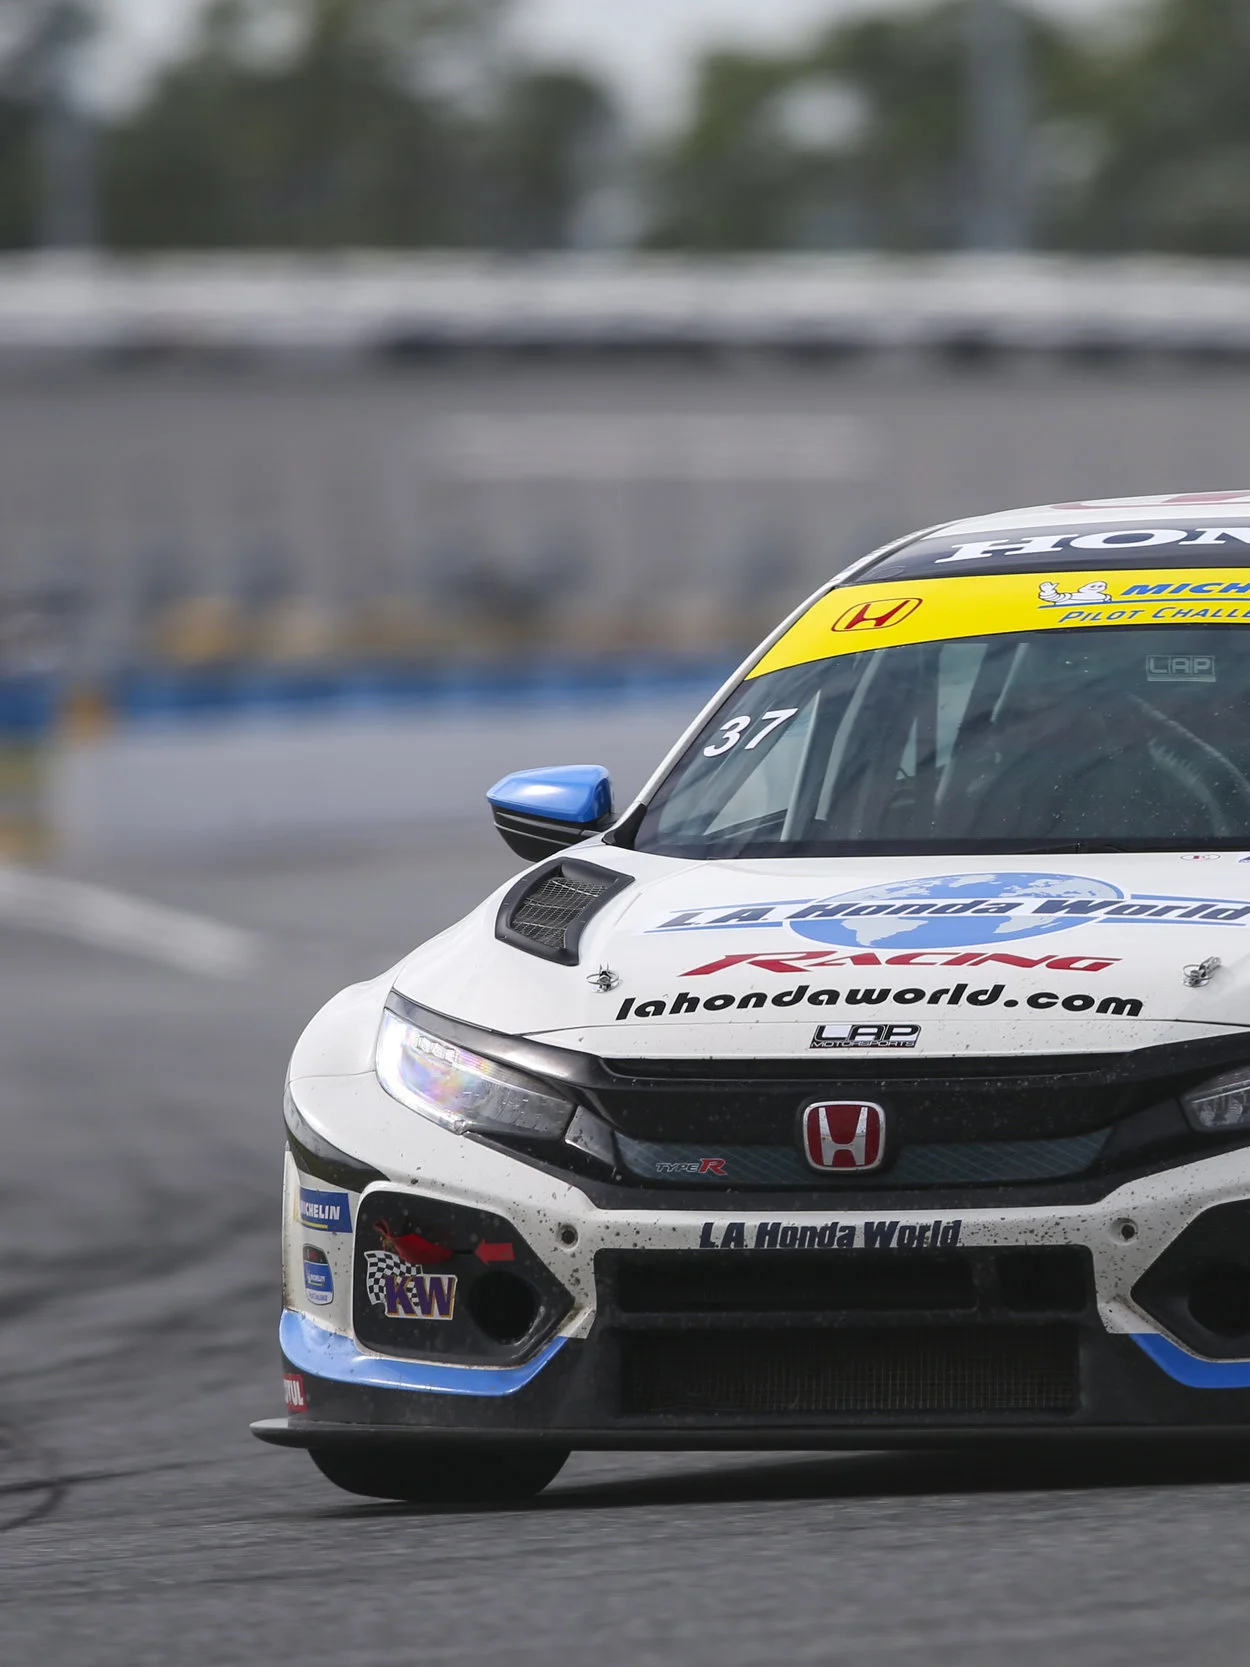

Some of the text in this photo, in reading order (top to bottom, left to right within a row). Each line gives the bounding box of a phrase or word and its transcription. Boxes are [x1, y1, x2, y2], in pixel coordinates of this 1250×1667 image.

[1058, 609, 1147, 623] PILOT
[1149, 656, 1212, 674] LAP
[703, 707, 799, 757] 37
[656, 906, 769, 929] L.A.
[784, 899, 1025, 920] Honda
[677, 950, 1123, 978] RACING
[615, 983, 1144, 1021] lahondaworld.com
[810, 1040, 916, 1048] MOTORSPORTS
[815, 1024, 922, 1041] LAP
[754, 1221, 857, 1249] Honda
[863, 1219, 963, 1248] World
[384, 1275, 458, 1318] KW
